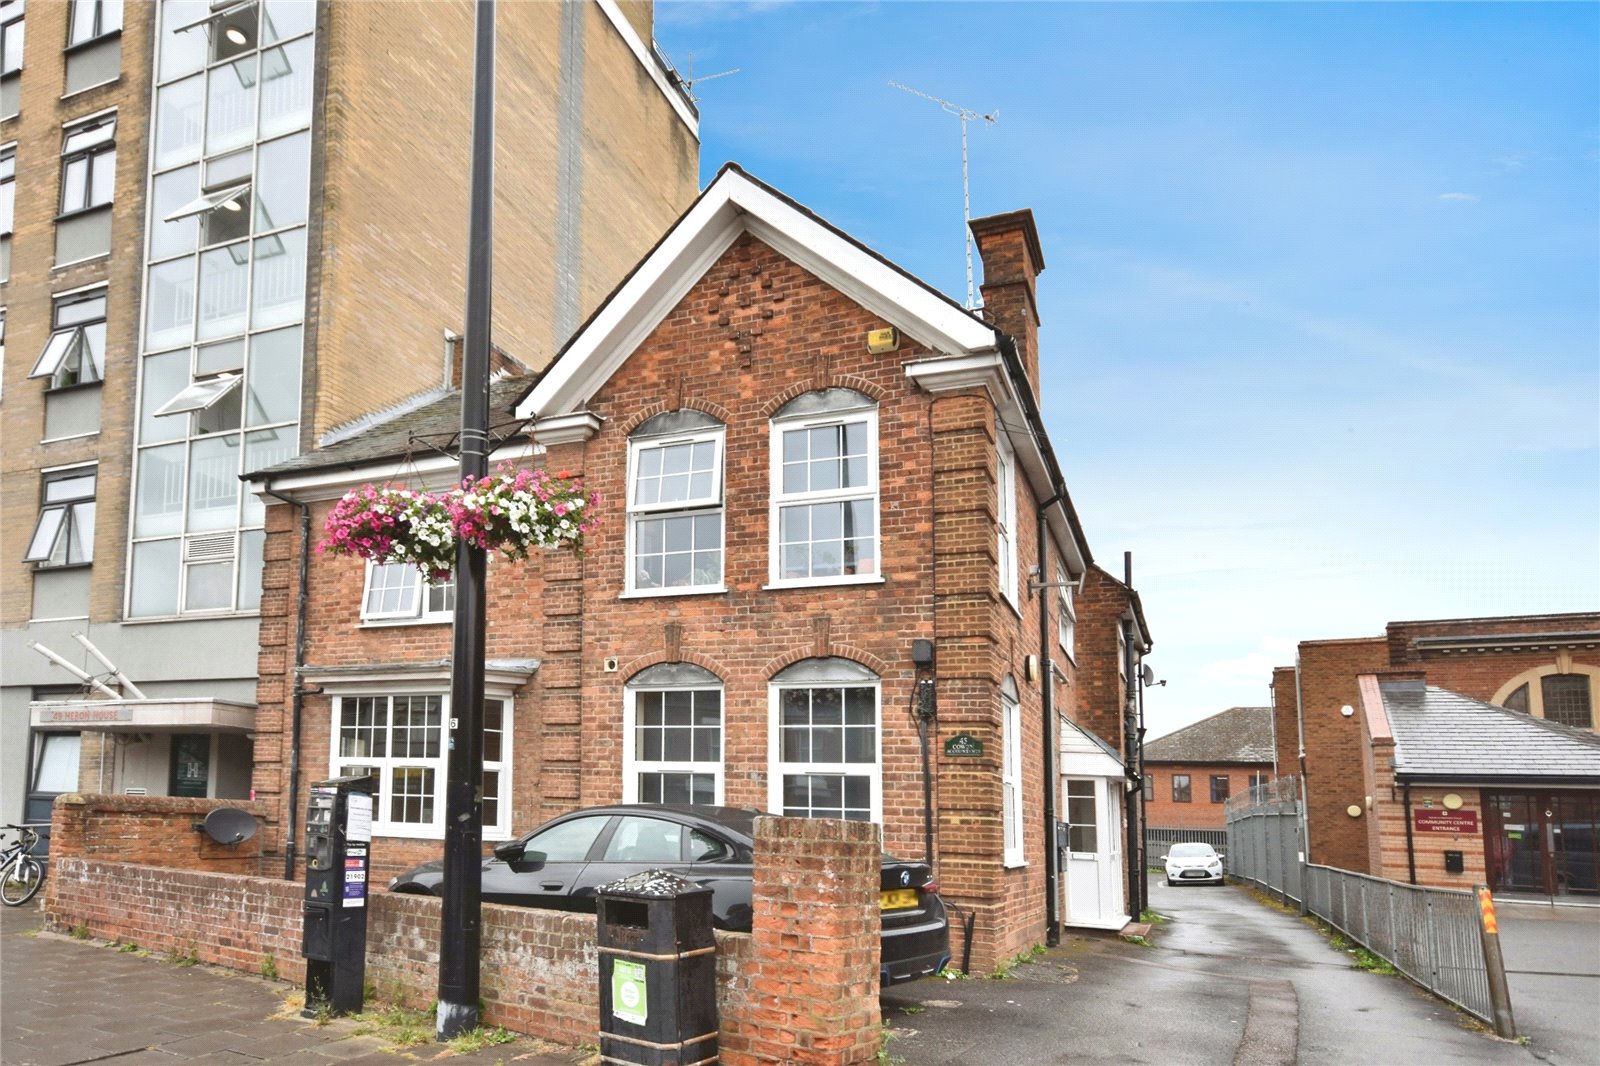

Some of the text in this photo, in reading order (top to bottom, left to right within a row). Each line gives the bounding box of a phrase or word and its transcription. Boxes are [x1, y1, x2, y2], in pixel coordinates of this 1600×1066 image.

[64, 711, 90, 720] HERON
[92, 711, 118, 720] HOUSE
[959, 737, 968, 745] 45
